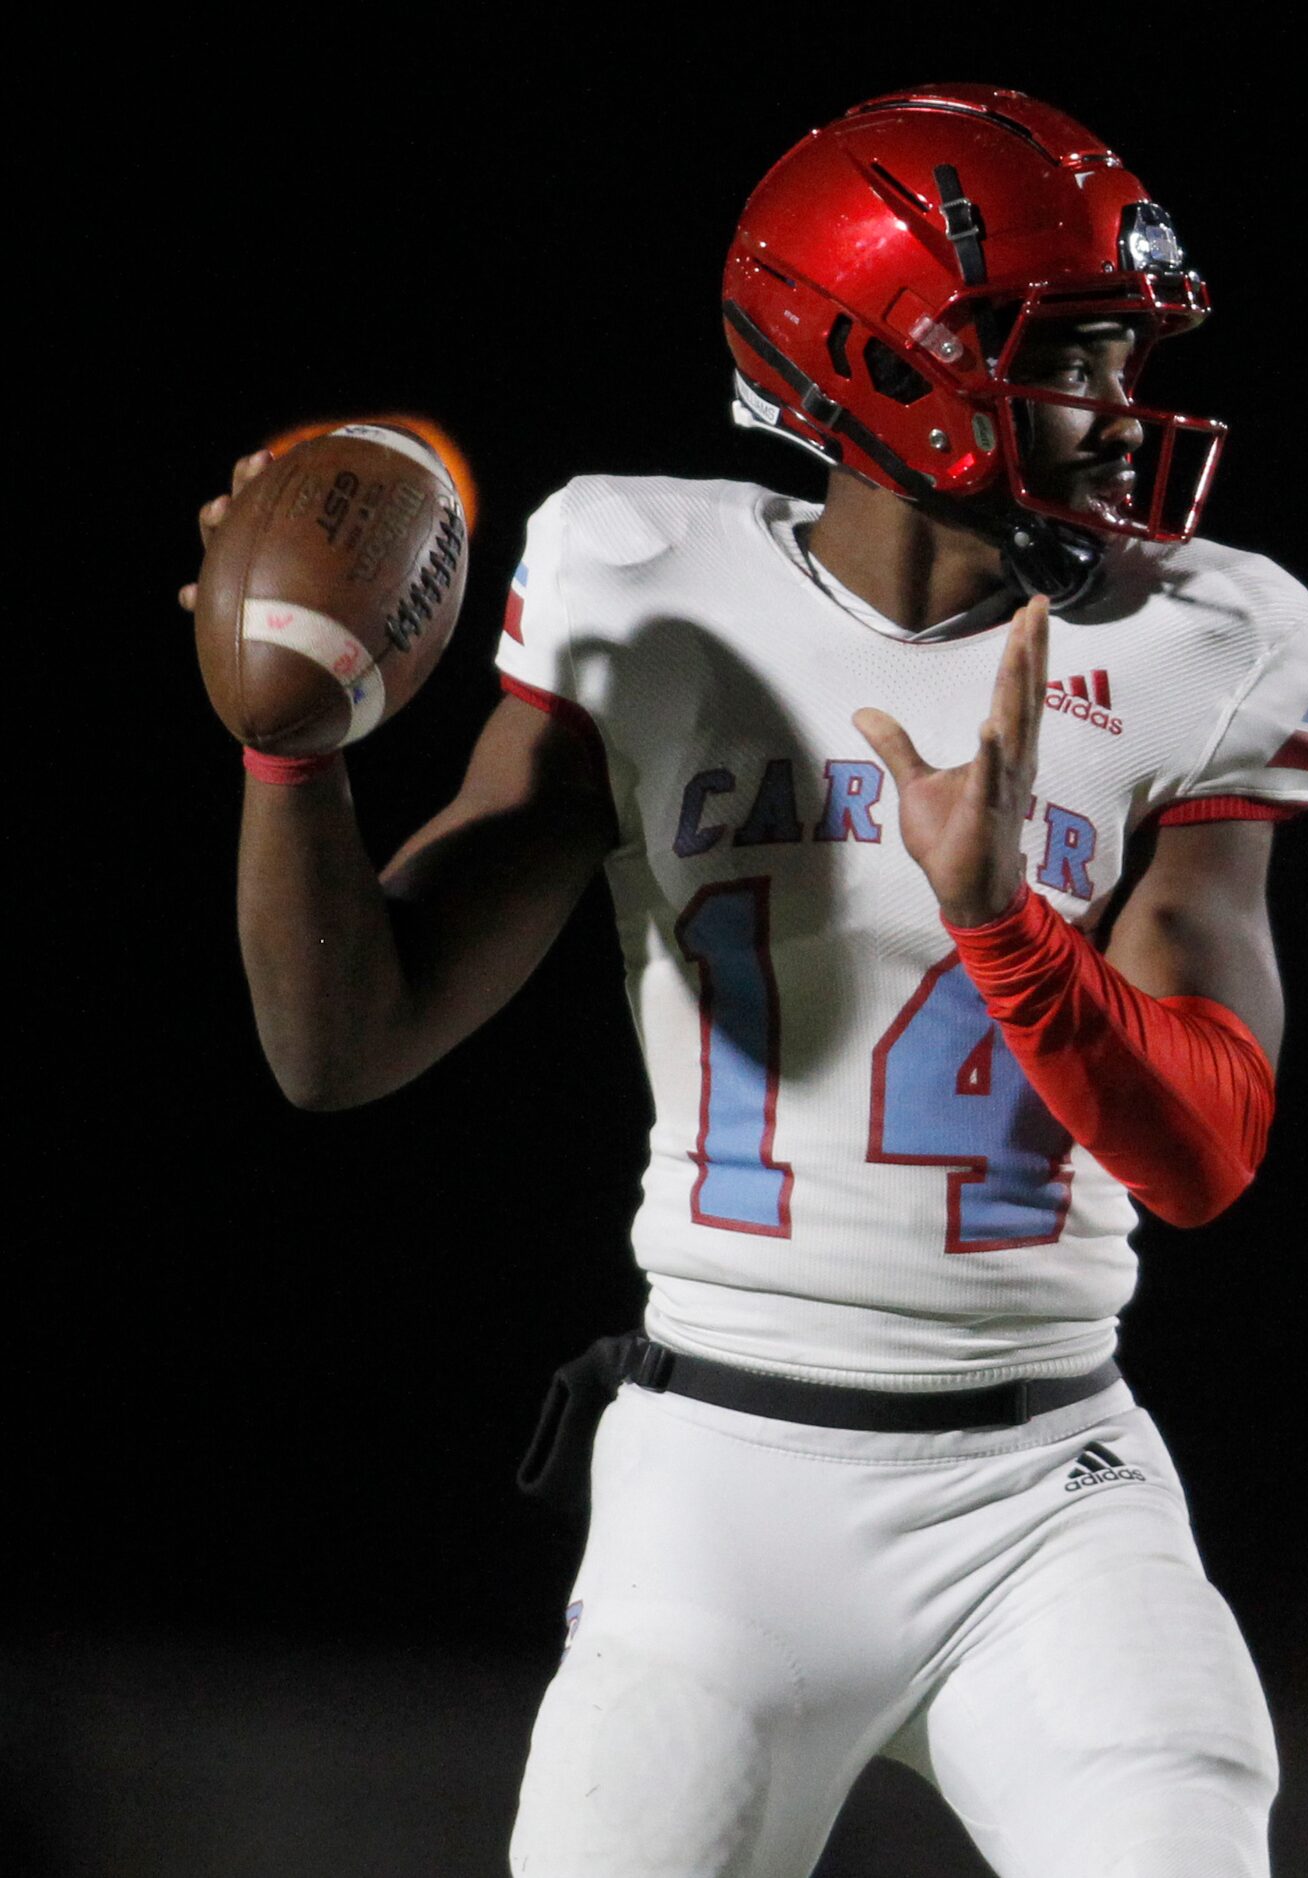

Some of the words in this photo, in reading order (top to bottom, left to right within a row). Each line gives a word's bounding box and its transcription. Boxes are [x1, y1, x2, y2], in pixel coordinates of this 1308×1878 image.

[318, 471, 360, 544] GST
[1044, 692, 1123, 735] didas
[674, 759, 1097, 900] CARR
[674, 875, 1075, 1254] 14
[1064, 1467, 1146, 1492] adidas
